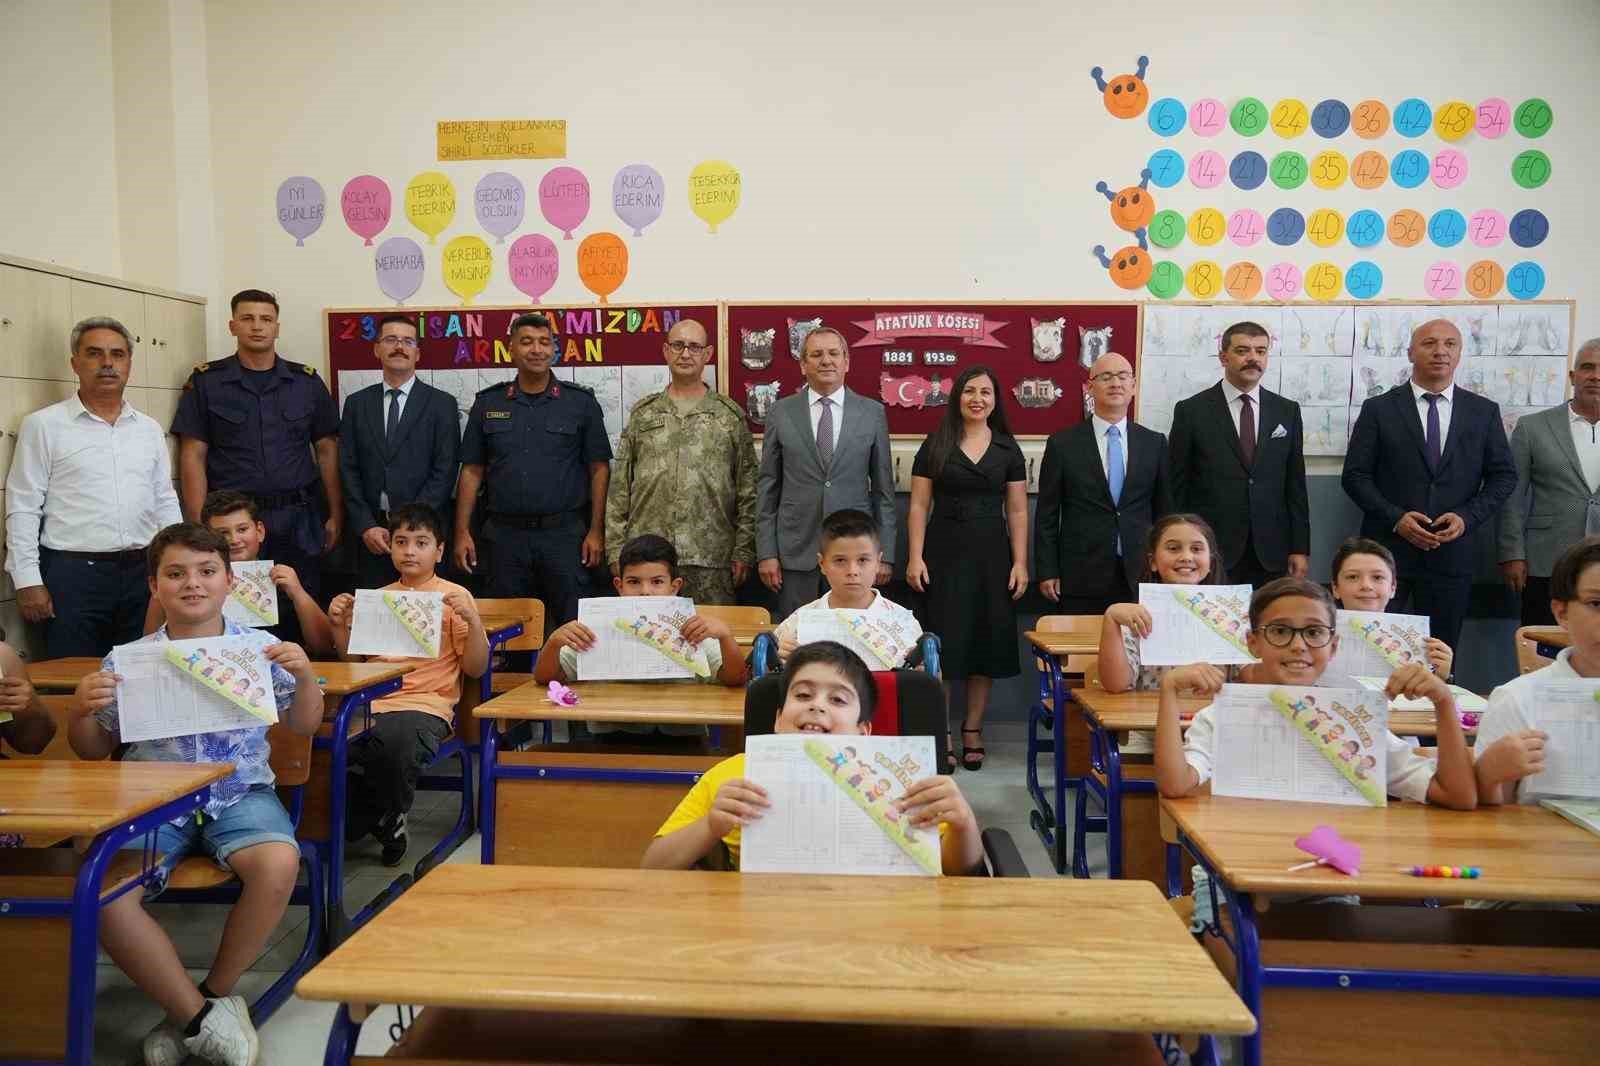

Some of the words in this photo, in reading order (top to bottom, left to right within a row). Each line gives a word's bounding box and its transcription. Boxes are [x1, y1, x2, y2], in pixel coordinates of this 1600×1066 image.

[1158, 103, 1175, 130] 6
[1197, 103, 1219, 127] 12
[1240, 103, 1258, 129] 18
[1276, 107, 1302, 133] 24
[1356, 105, 1381, 132] 36
[1400, 103, 1427, 129] 42
[1439, 104, 1471, 132] 48
[1479, 106, 1505, 130] 54
[1520, 103, 1549, 129] 60
[1155, 155, 1174, 178] 7
[1197, 155, 1217, 183] 14
[1234, 156, 1256, 180] 21
[1277, 155, 1300, 181] 28
[1316, 156, 1341, 181] 35
[1356, 153, 1384, 182] 42
[1396, 152, 1420, 178] 49
[1435, 155, 1460, 180] 56
[1519, 155, 1546, 183] 70
[344, 191, 378, 204] KOLAY
[482, 204, 518, 218] OLSUN
[1159, 215, 1174, 240] 8
[1197, 214, 1215, 240] 16
[1232, 214, 1262, 240] 24
[1310, 212, 1341, 240] 40
[1352, 214, 1377, 241] 48
[1392, 214, 1420, 242] 56
[1431, 214, 1458, 240] 64
[1474, 216, 1499, 240] 72
[375, 254, 425, 271] MERHABA
[1155, 265, 1172, 293] 9
[1193, 264, 1211, 295] 18
[1229, 265, 1256, 291] 27
[1271, 267, 1296, 292] 36
[1311, 265, 1337, 292] 45
[1351, 268, 1376, 294] 54
[1431, 269, 1457, 291] 72
[1472, 264, 1495, 293] 81
[1513, 266, 1540, 293] 90
[337, 315, 377, 341] 23
[408, 311, 484, 339] İSAN
[876, 312, 933, 331] ATATÜRK
[884, 351, 913, 363] 1881
